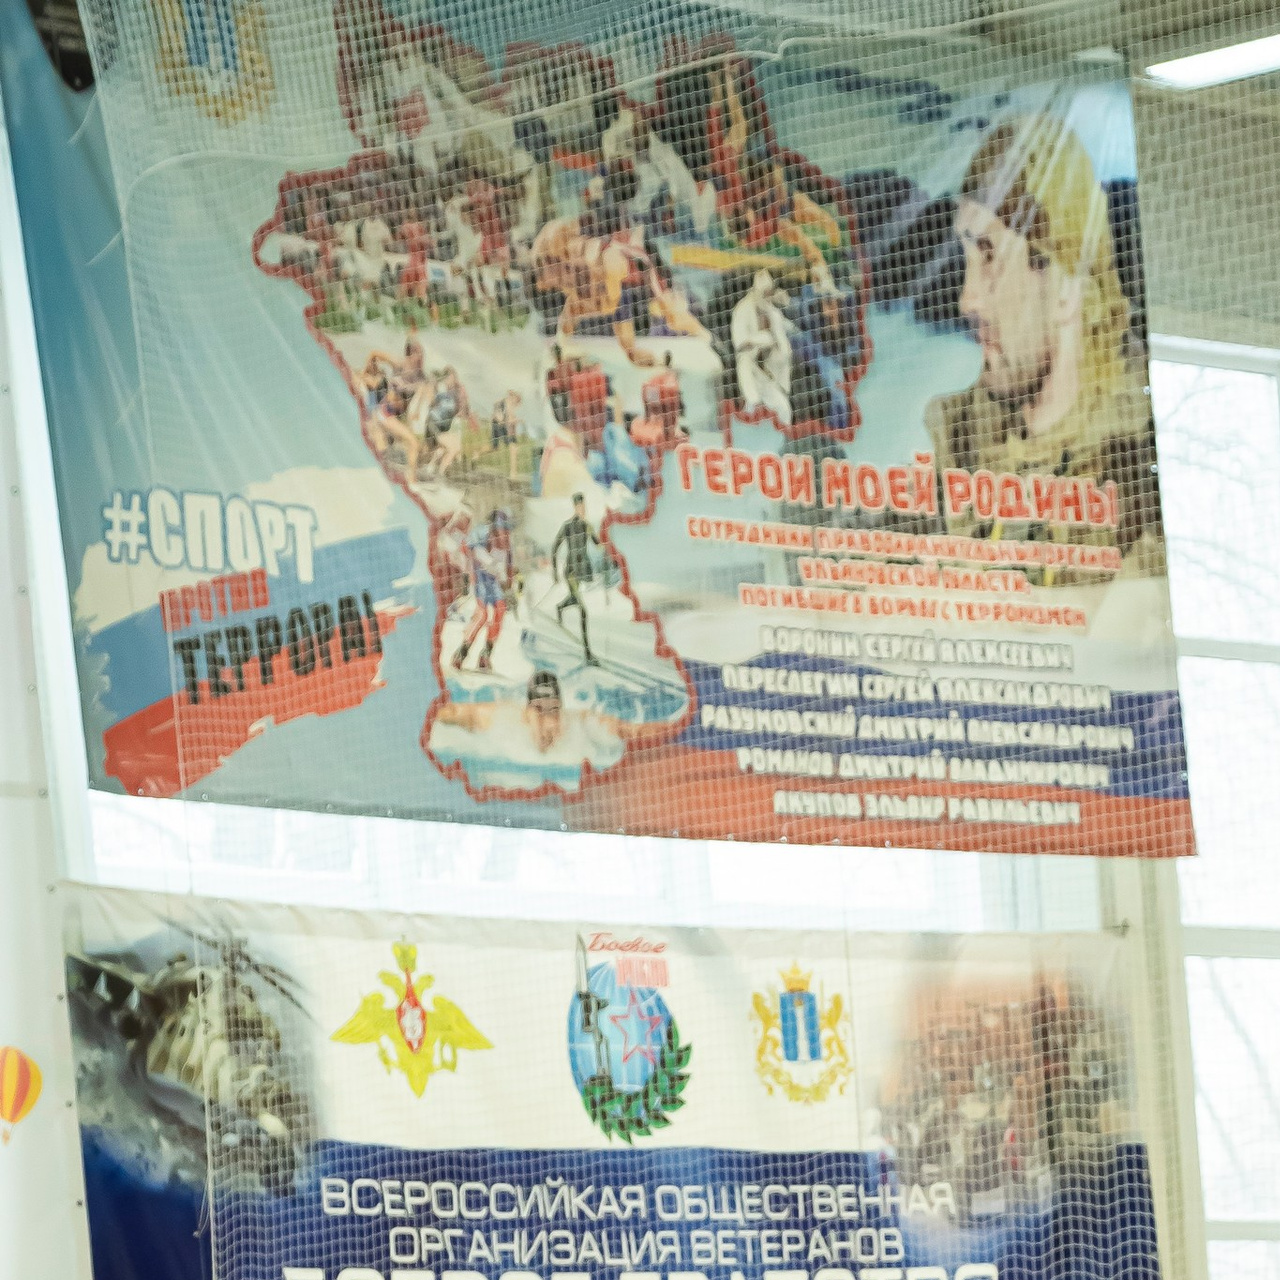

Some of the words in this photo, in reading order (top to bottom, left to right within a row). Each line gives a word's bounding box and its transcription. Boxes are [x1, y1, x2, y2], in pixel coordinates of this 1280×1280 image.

[676, 445, 815, 505] ГЕРОИ
[821, 453, 936, 515] МОЕЙ
[943, 468, 1118, 525] РОДИНЫ
[103, 485, 317, 583] #СПОРТ
[173, 588, 382, 705] ТЕРРОРА!
[863, 629, 936, 663] СЕРГЕЙ
[701, 704, 856, 737] РАЗУМОВСКИЙ
[858, 710, 964, 743] ДМИТРИЙ
[321, 1176, 647, 1221] ВСЕРОССИЙКАЯ
[655, 1181, 956, 1226] ОБЩЕСТВЕННАЯ
[389, 1226, 682, 1270] ОРГАНИЗАЦИЯ
[690, 1227, 905, 1266] ВЕТЕРАНОВ
